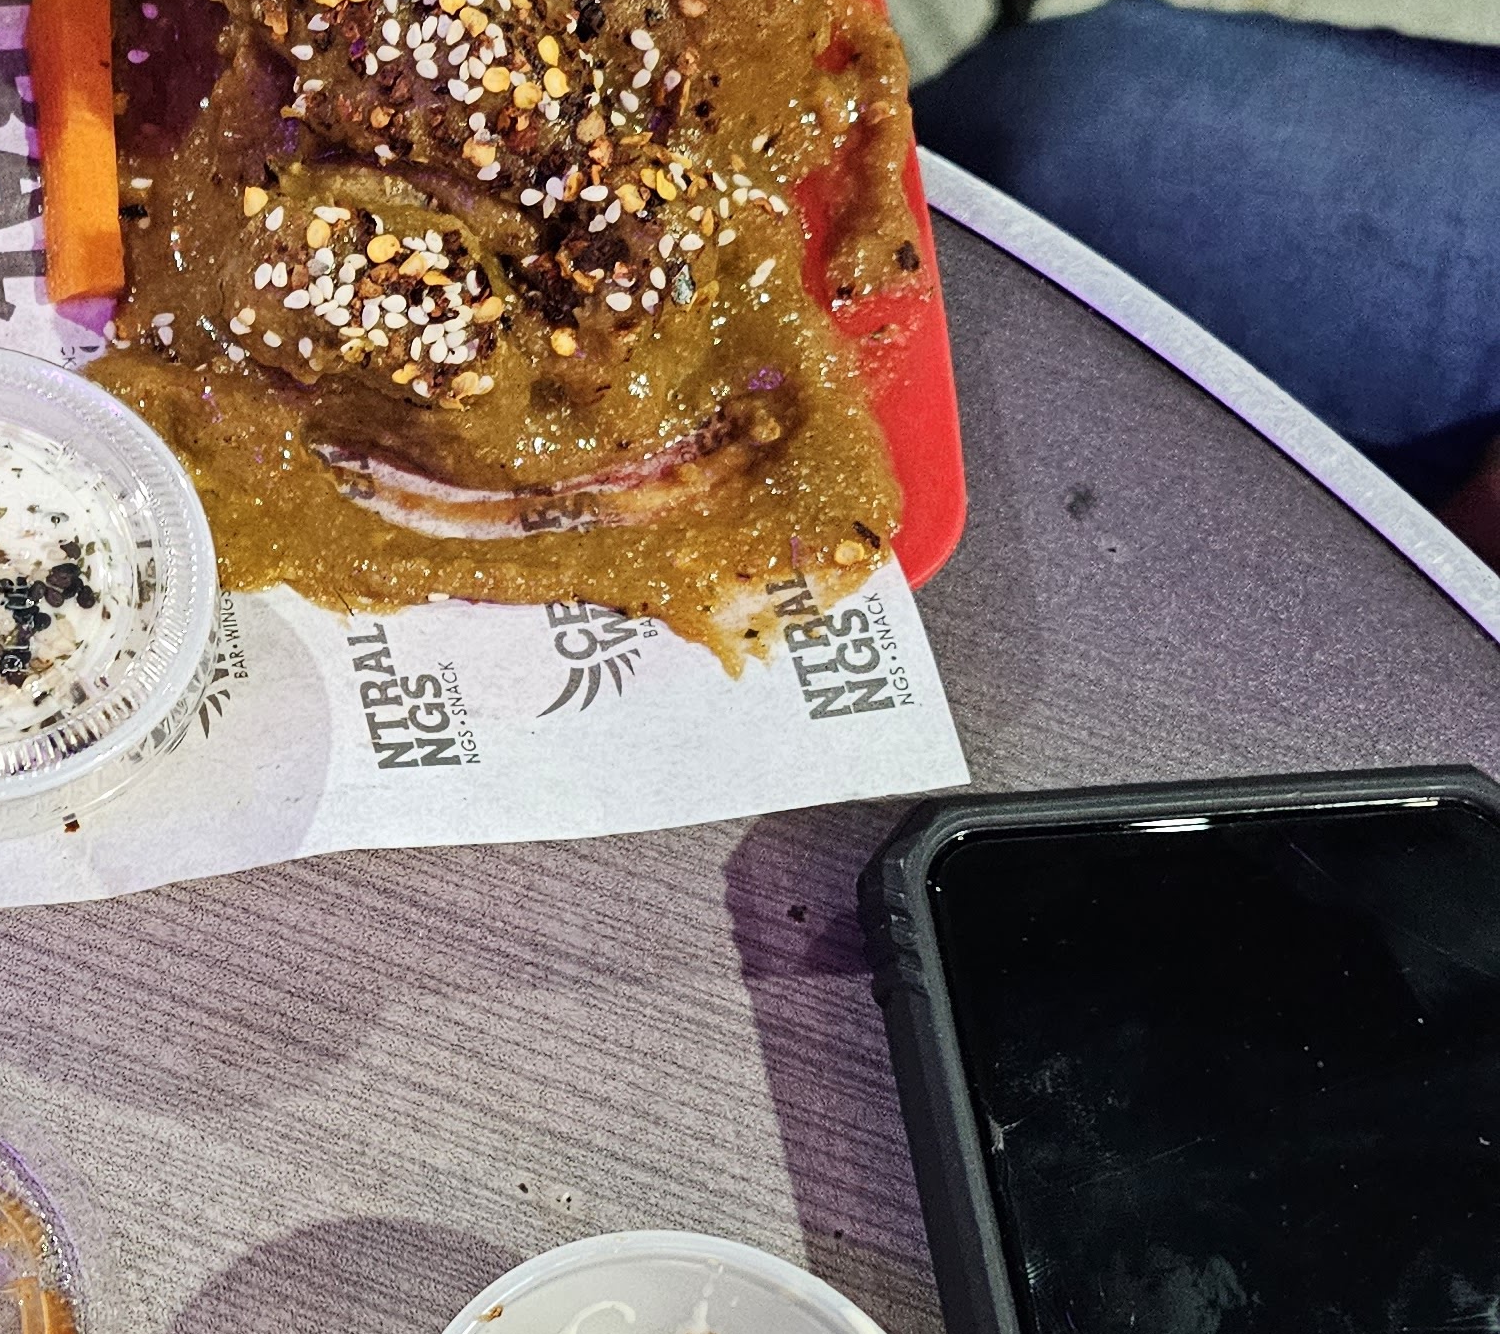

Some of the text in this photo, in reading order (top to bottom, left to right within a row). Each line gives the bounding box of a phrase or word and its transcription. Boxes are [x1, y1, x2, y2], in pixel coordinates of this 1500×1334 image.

[862, 591, 898, 651] SNACK
[229, 650, 249, 680] BAR
[437, 660, 468, 717] SNACK
